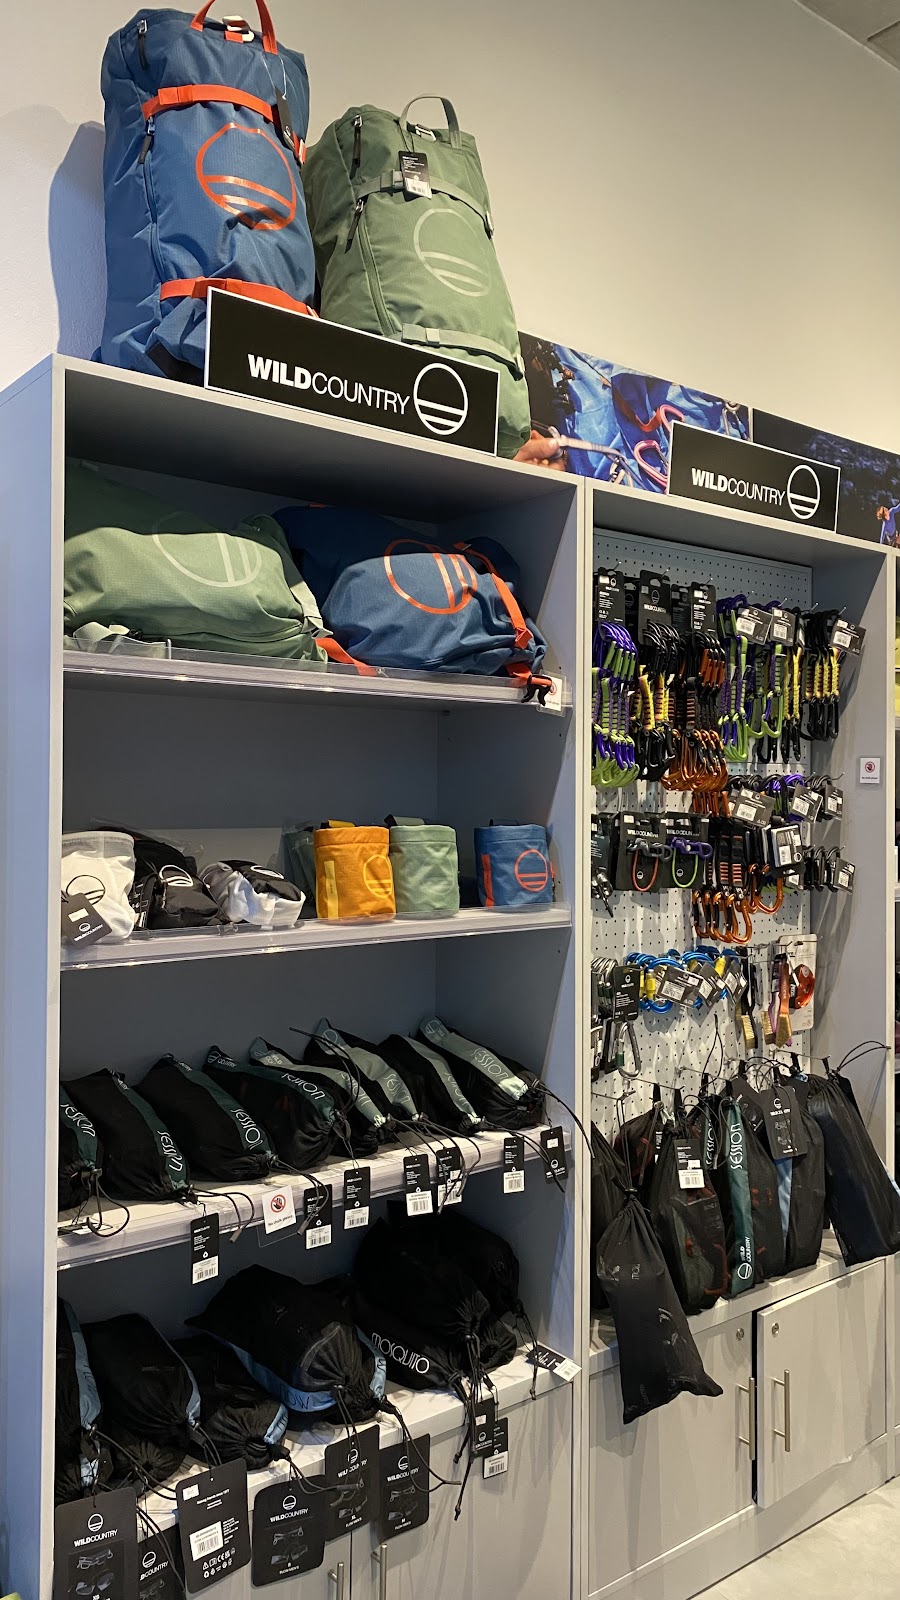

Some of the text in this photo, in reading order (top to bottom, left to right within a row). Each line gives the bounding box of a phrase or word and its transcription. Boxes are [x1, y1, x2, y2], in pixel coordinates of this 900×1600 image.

[247, 353, 410, 414] WILDCOUNTRY
[691, 467, 786, 506] WILDCOUNTRY
[472, 1047, 509, 1082] SESSION
[281, 1072, 326, 1101] SESSION
[229, 1108, 264, 1151] SESSION
[705, 1118, 715, 1165] SESSIO
[729, 1123, 744, 1170] SESSION
[372, 1332, 430, 1375] MOSQUITO
[337, 1458, 368, 1478] WILCOUNRY
[73, 1529, 118, 1548] WILDCOUNTRY
[140, 1561, 169, 1581] DCOUNTRY
